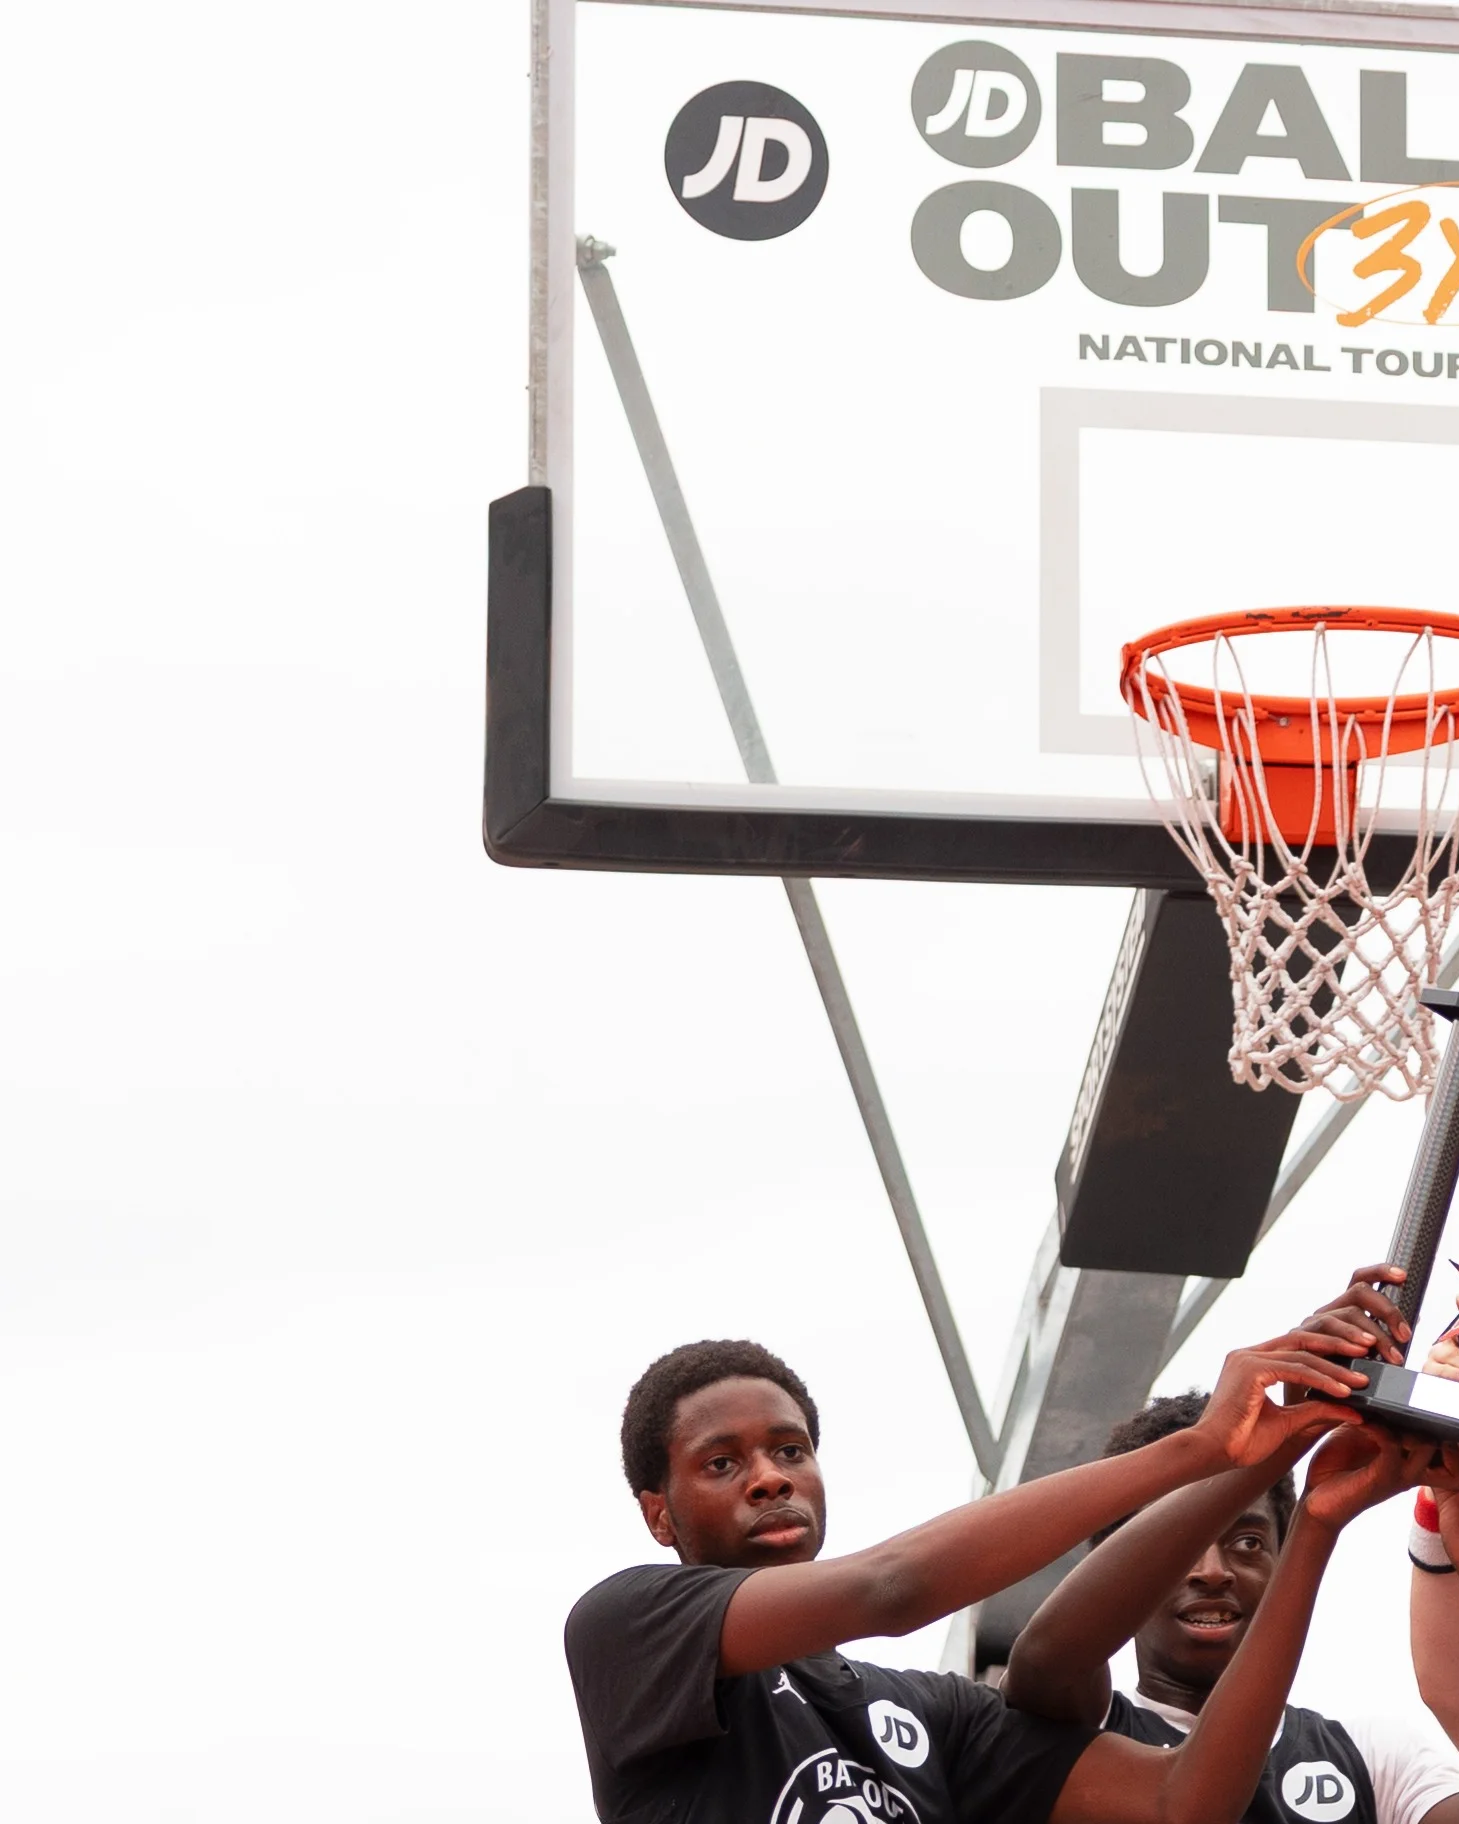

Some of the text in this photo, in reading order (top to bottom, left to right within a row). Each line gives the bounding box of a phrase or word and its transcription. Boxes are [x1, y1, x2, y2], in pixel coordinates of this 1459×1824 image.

[926, 69, 1028, 138] JD
[681, 115, 812, 203] JD
[910, 180, 1366, 313] OUT
[1078, 333, 1332, 373] NATIONAL
[880, 1715, 919, 1751] JD
[817, 1759, 857, 1792] BA
[1294, 1774, 1344, 1806] JD
